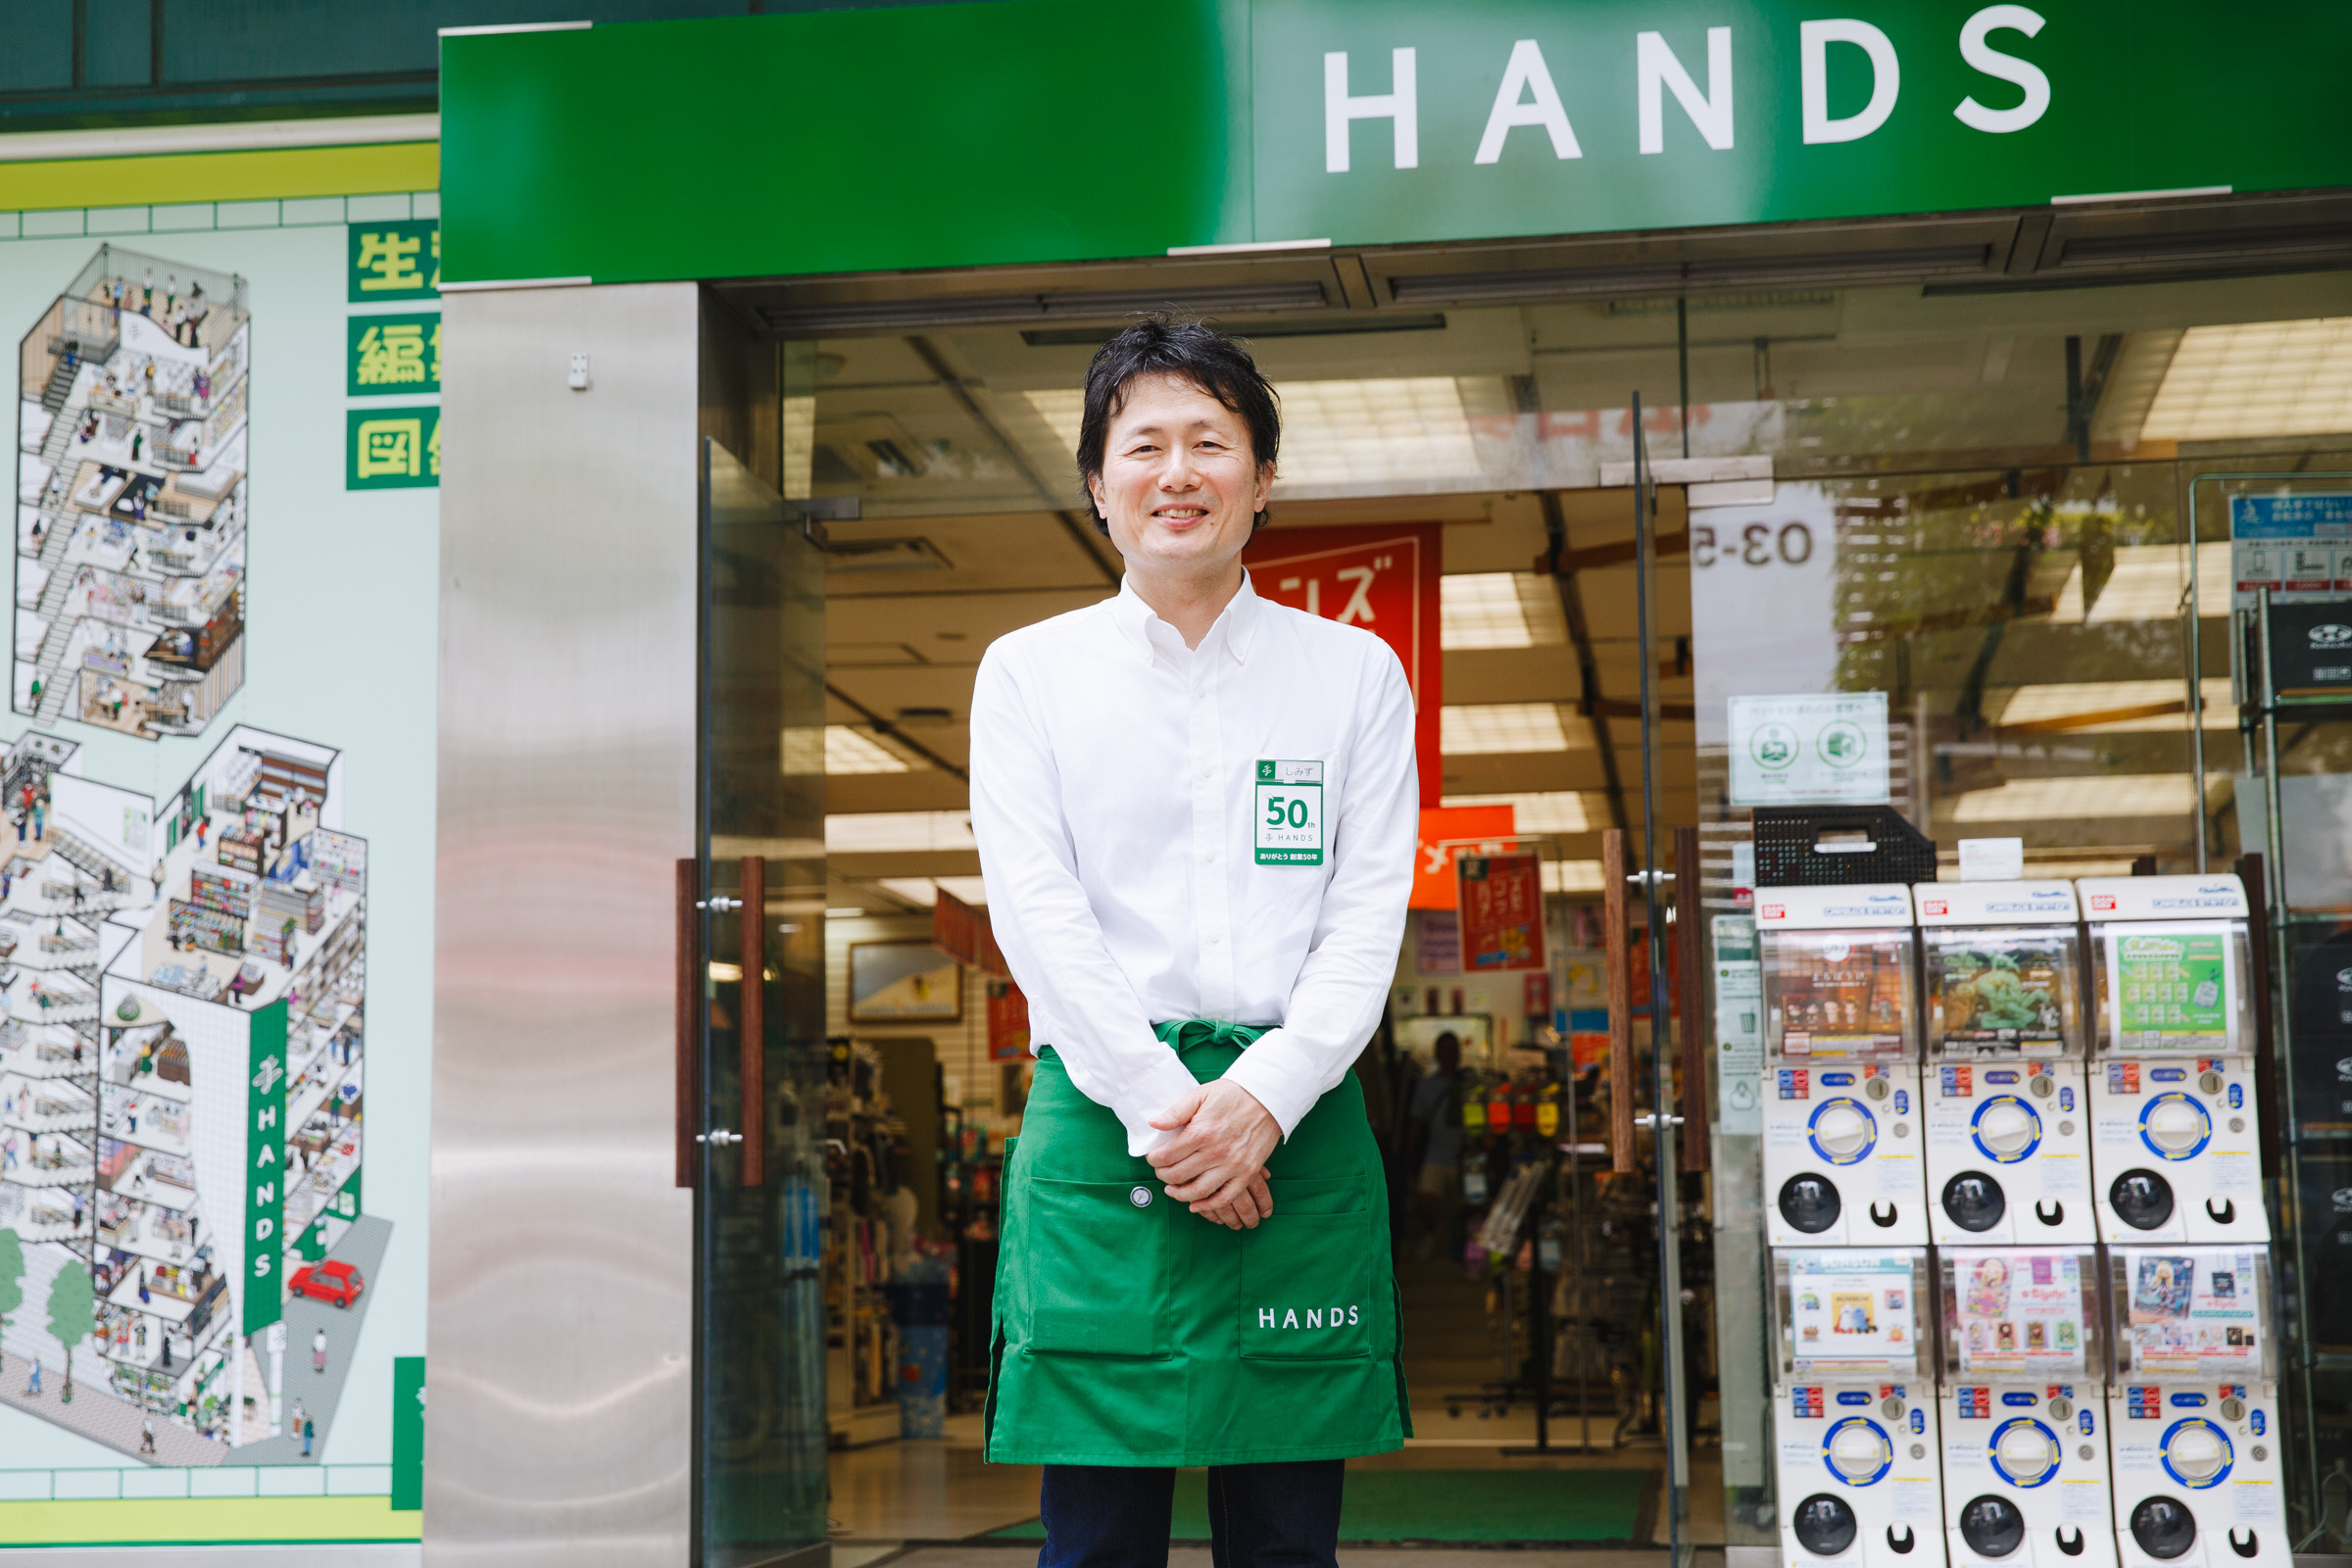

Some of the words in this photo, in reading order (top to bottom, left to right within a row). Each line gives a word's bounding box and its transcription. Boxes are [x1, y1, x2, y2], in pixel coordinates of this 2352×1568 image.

[1324, 6, 2051, 173] HANDS
[1285, 767, 1313, 777] しみず
[1290, 853, 1319, 861] 創業50年
[254, 1104, 276, 1278] HANDS
[1258, 1304, 1359, 1330] HANDS
